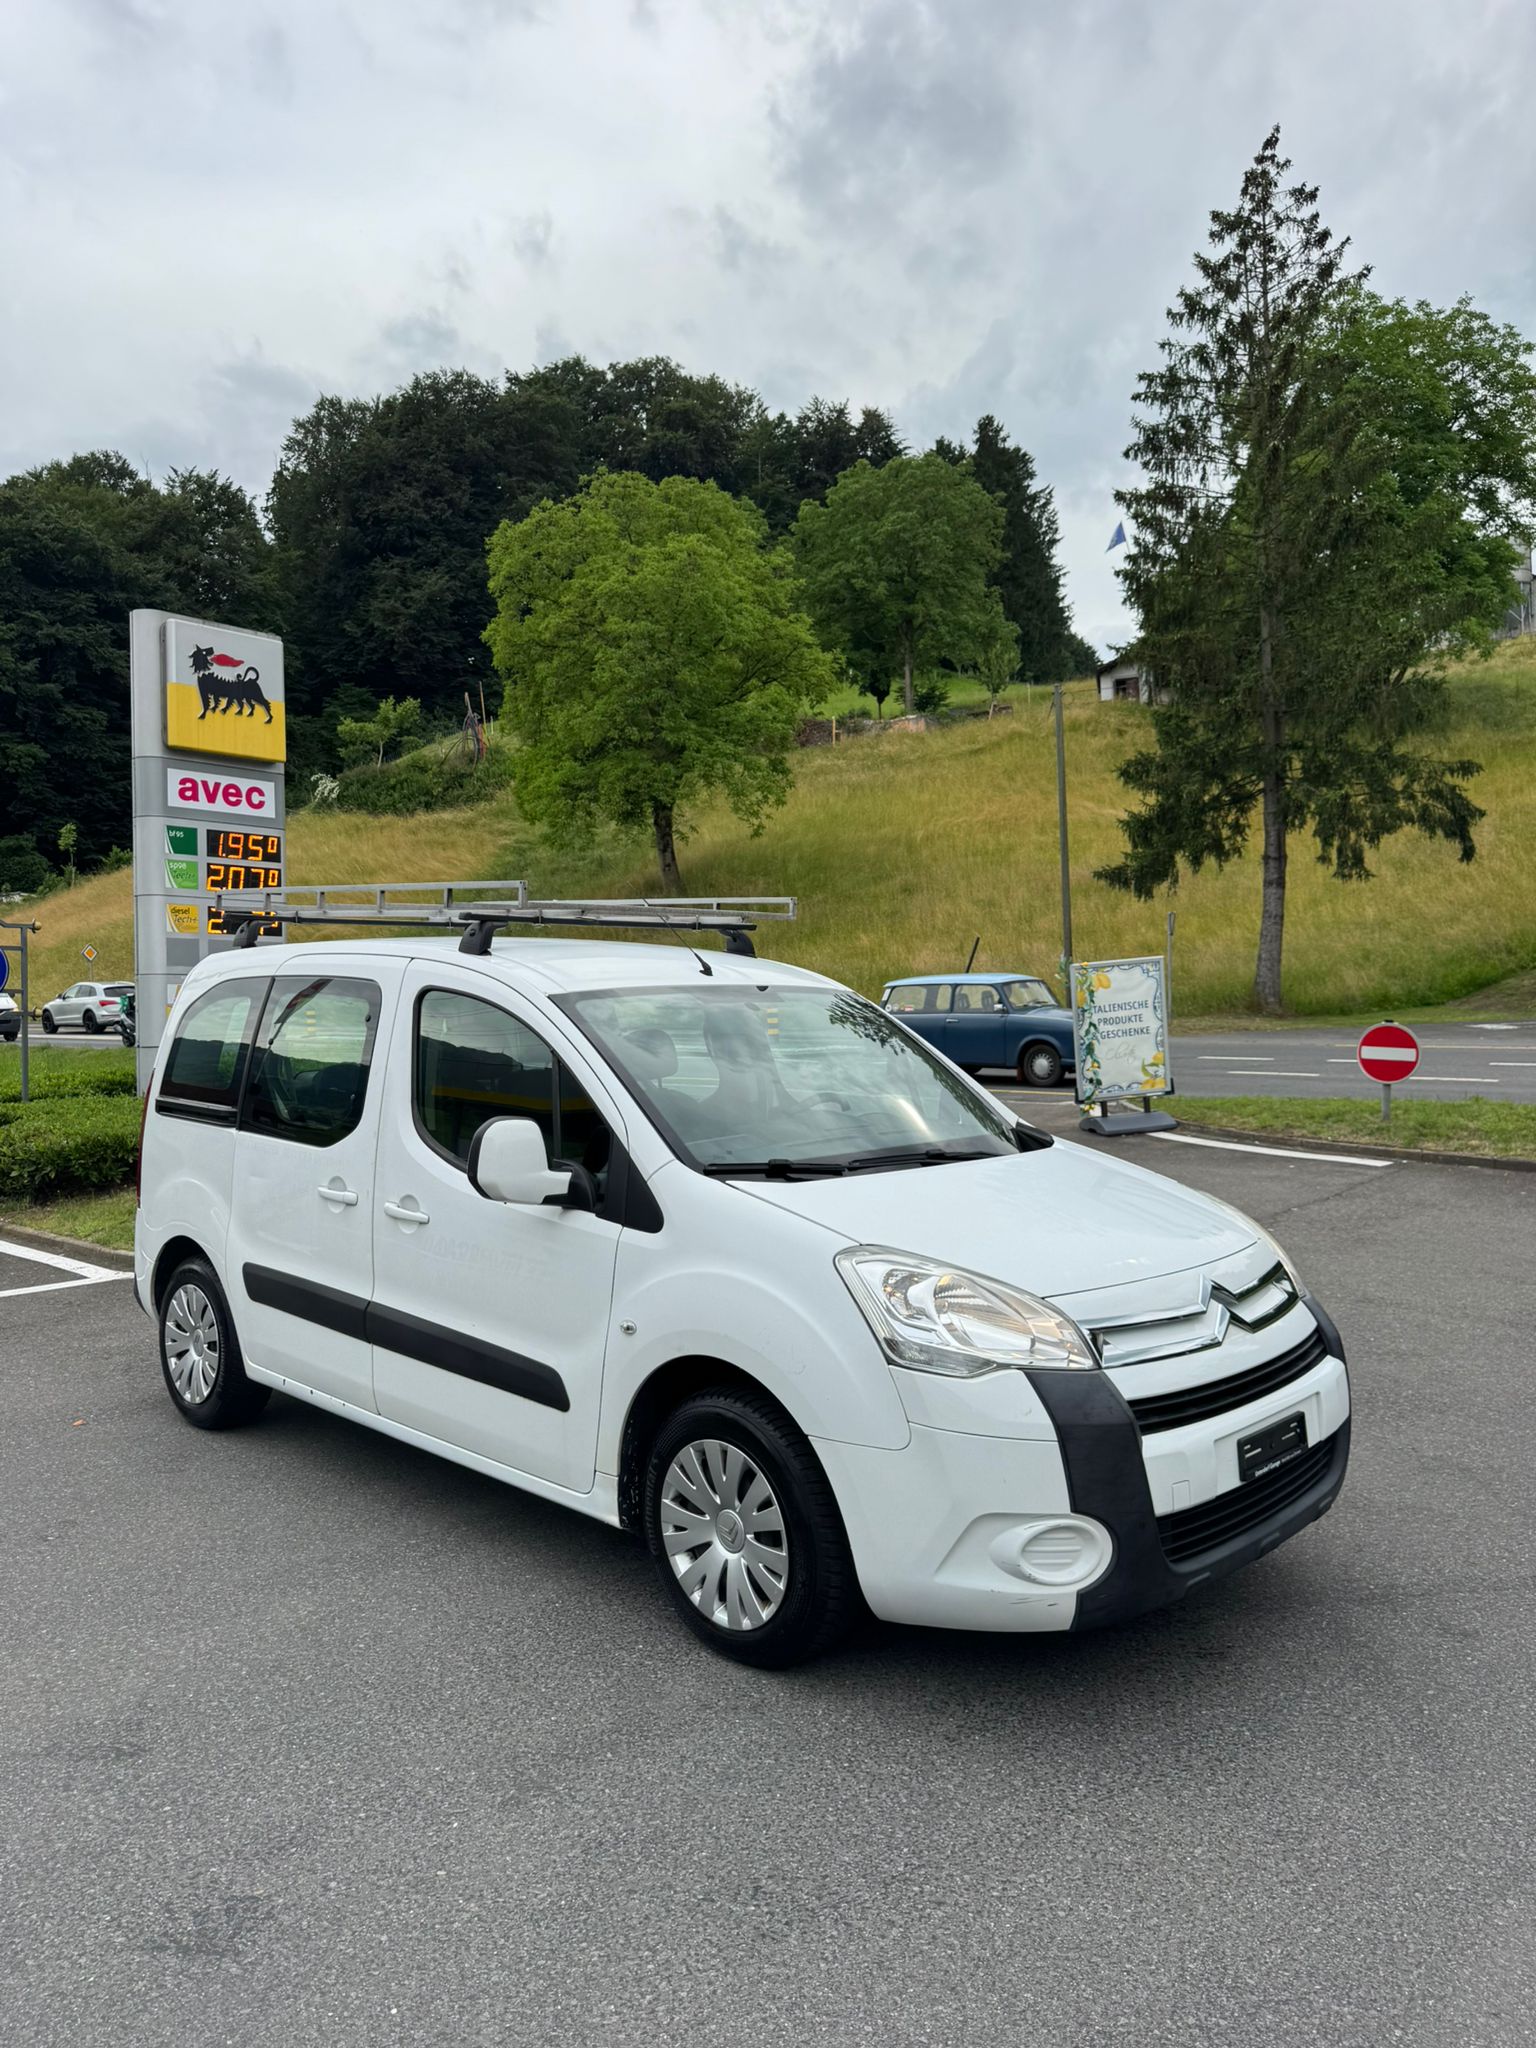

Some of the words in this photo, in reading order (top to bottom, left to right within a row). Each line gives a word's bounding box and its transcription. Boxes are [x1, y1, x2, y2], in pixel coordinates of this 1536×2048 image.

[178, 777, 266, 810] avec
[170, 907, 191, 915] diesel
[1092, 999, 1149, 1014] TALIENISCHE
[1097, 1013, 1144, 1027] PRODUKTE
[1100, 1025, 1150, 1040] GESCHENKE
